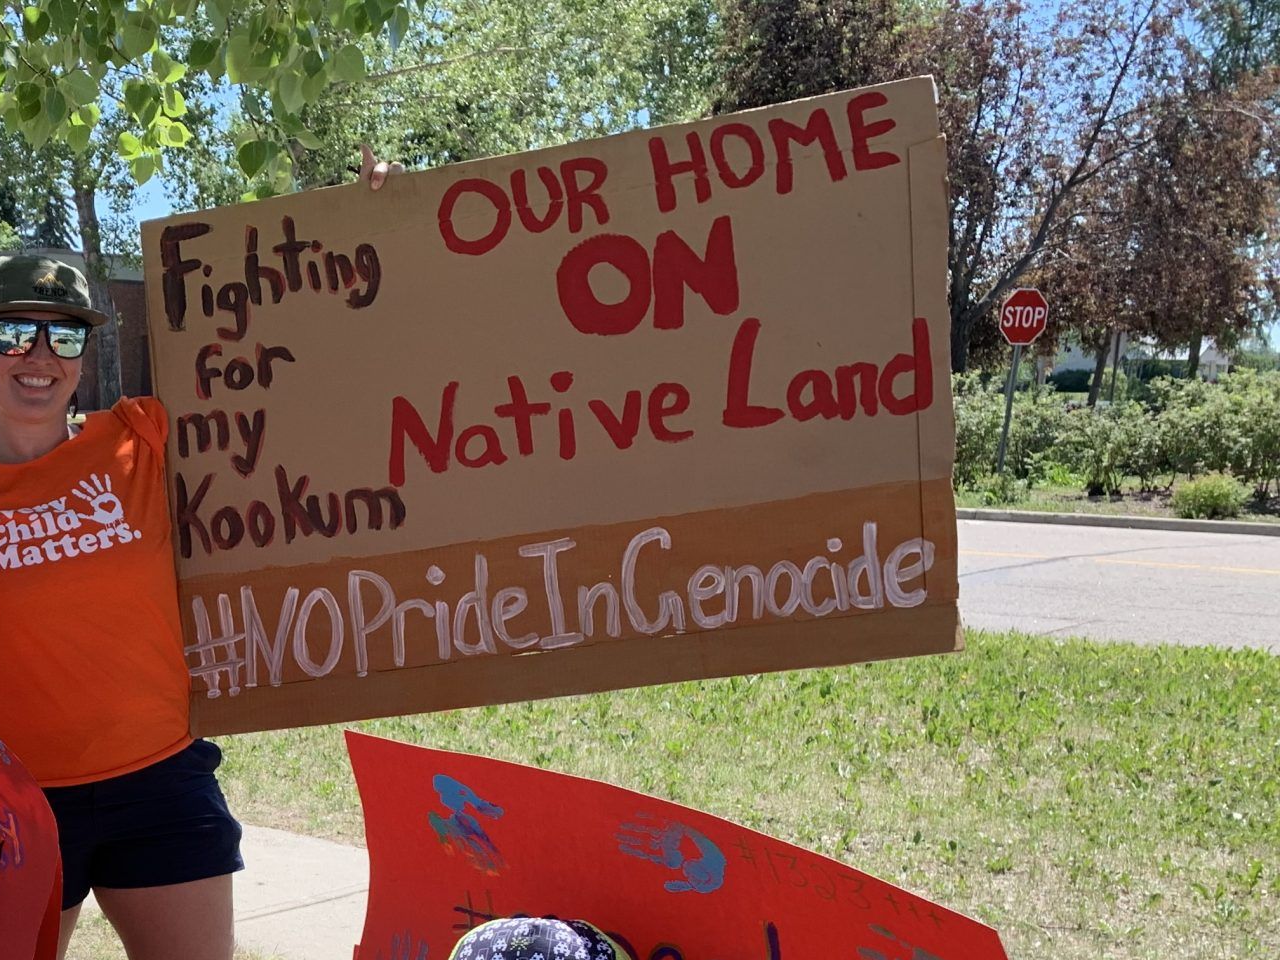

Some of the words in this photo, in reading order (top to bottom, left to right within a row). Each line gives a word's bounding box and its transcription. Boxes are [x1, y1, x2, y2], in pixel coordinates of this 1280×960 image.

[437, 157, 610, 256] OUR
[647, 91, 902, 213] HOME
[159, 214, 382, 342] Fighting
[556, 215, 740, 337] ON
[1003, 306, 1045, 328] STOP
[176, 408, 266, 478] my
[389, 371, 695, 486] Native
[723, 317, 934, 430] Land
